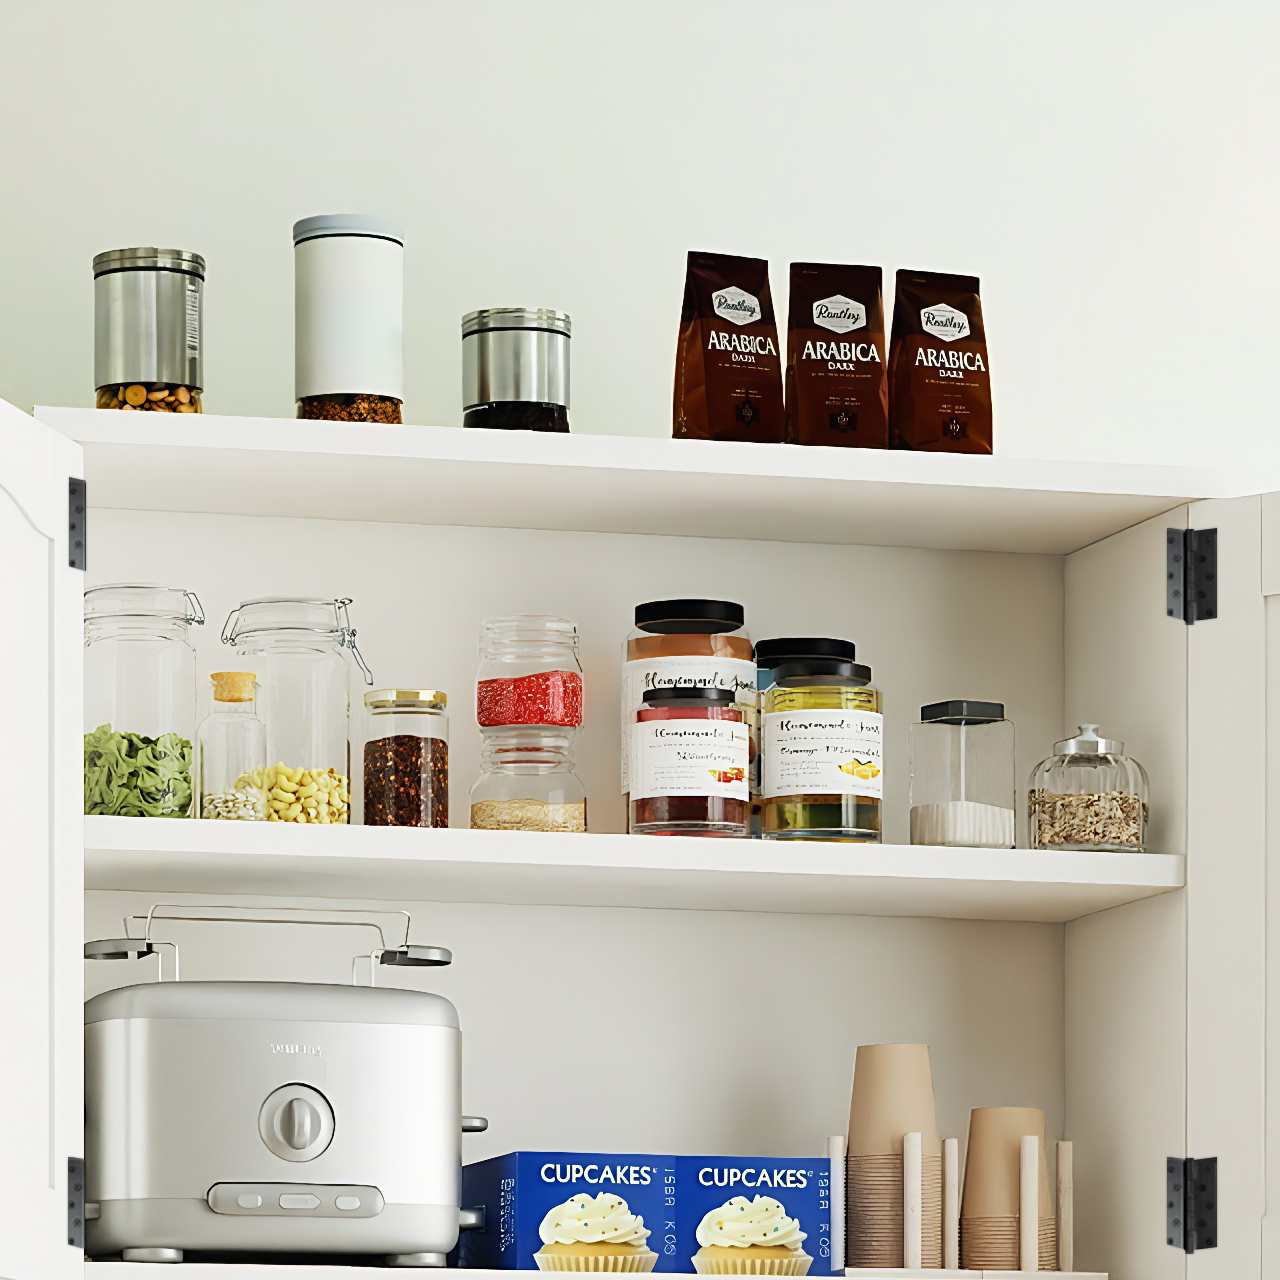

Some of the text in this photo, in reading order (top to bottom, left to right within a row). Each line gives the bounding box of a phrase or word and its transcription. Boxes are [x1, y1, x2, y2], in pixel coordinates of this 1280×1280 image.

[707, 331, 777, 356] ARABICA
[802, 341, 881, 363] ARABICA
[915, 347, 986, 372] ARABICA
